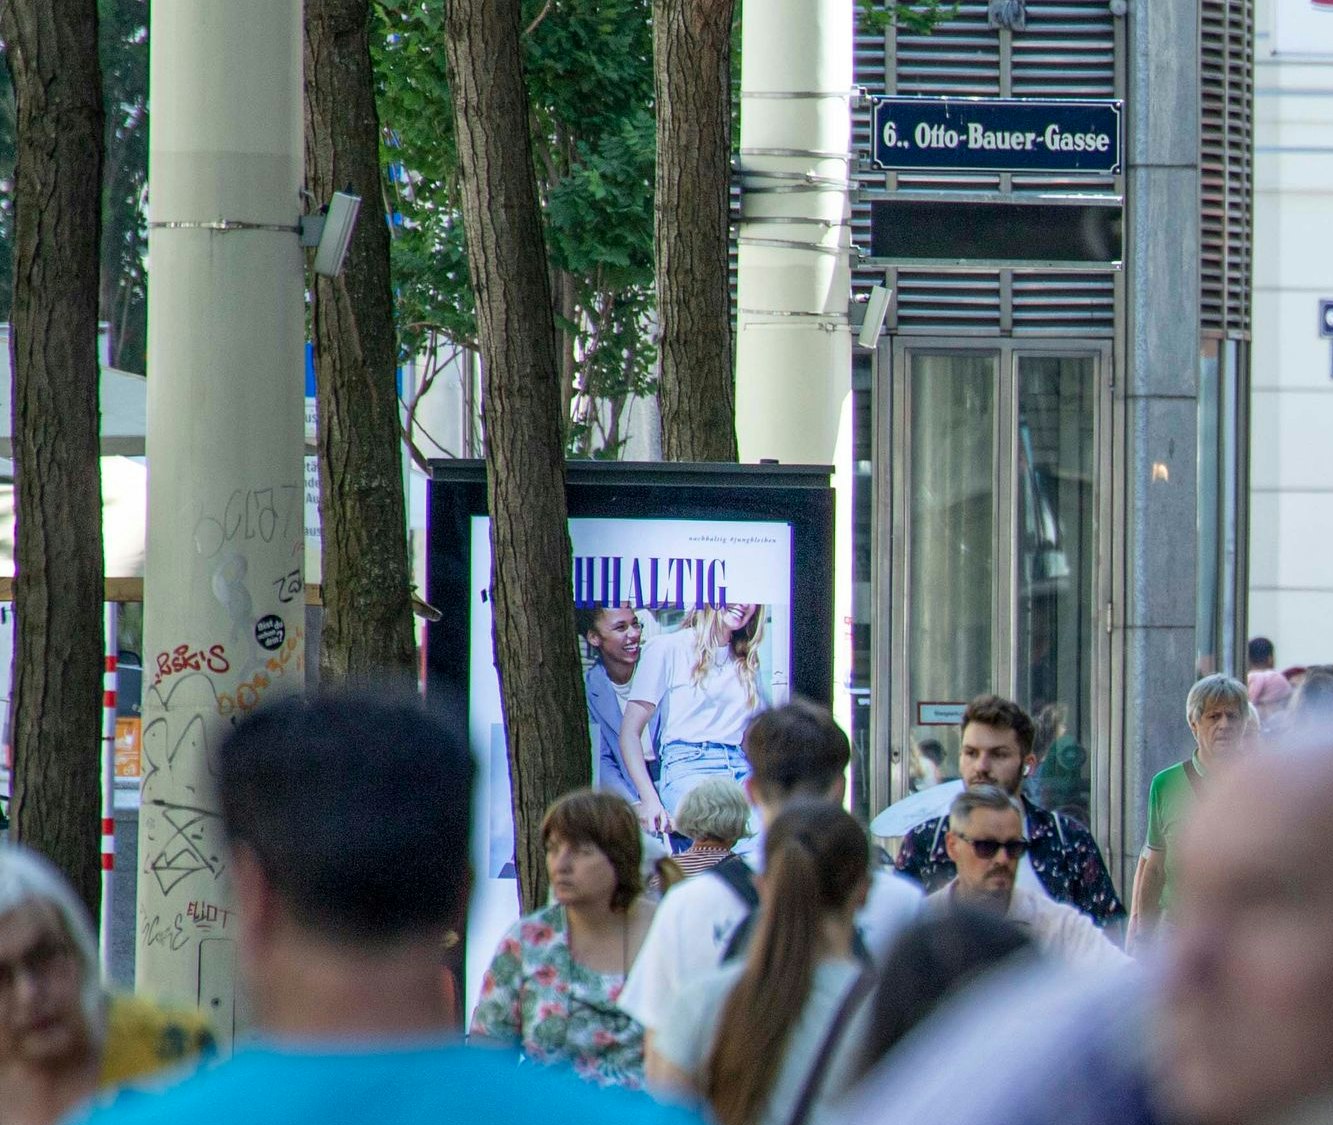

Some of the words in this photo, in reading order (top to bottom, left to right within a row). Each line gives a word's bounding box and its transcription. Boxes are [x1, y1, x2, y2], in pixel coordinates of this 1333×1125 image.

[883, 121, 909, 149] 6.,
[914, 122, 1110, 151] Otto-Bauer-Gasse
[574, 556, 728, 611] HHALTIG
